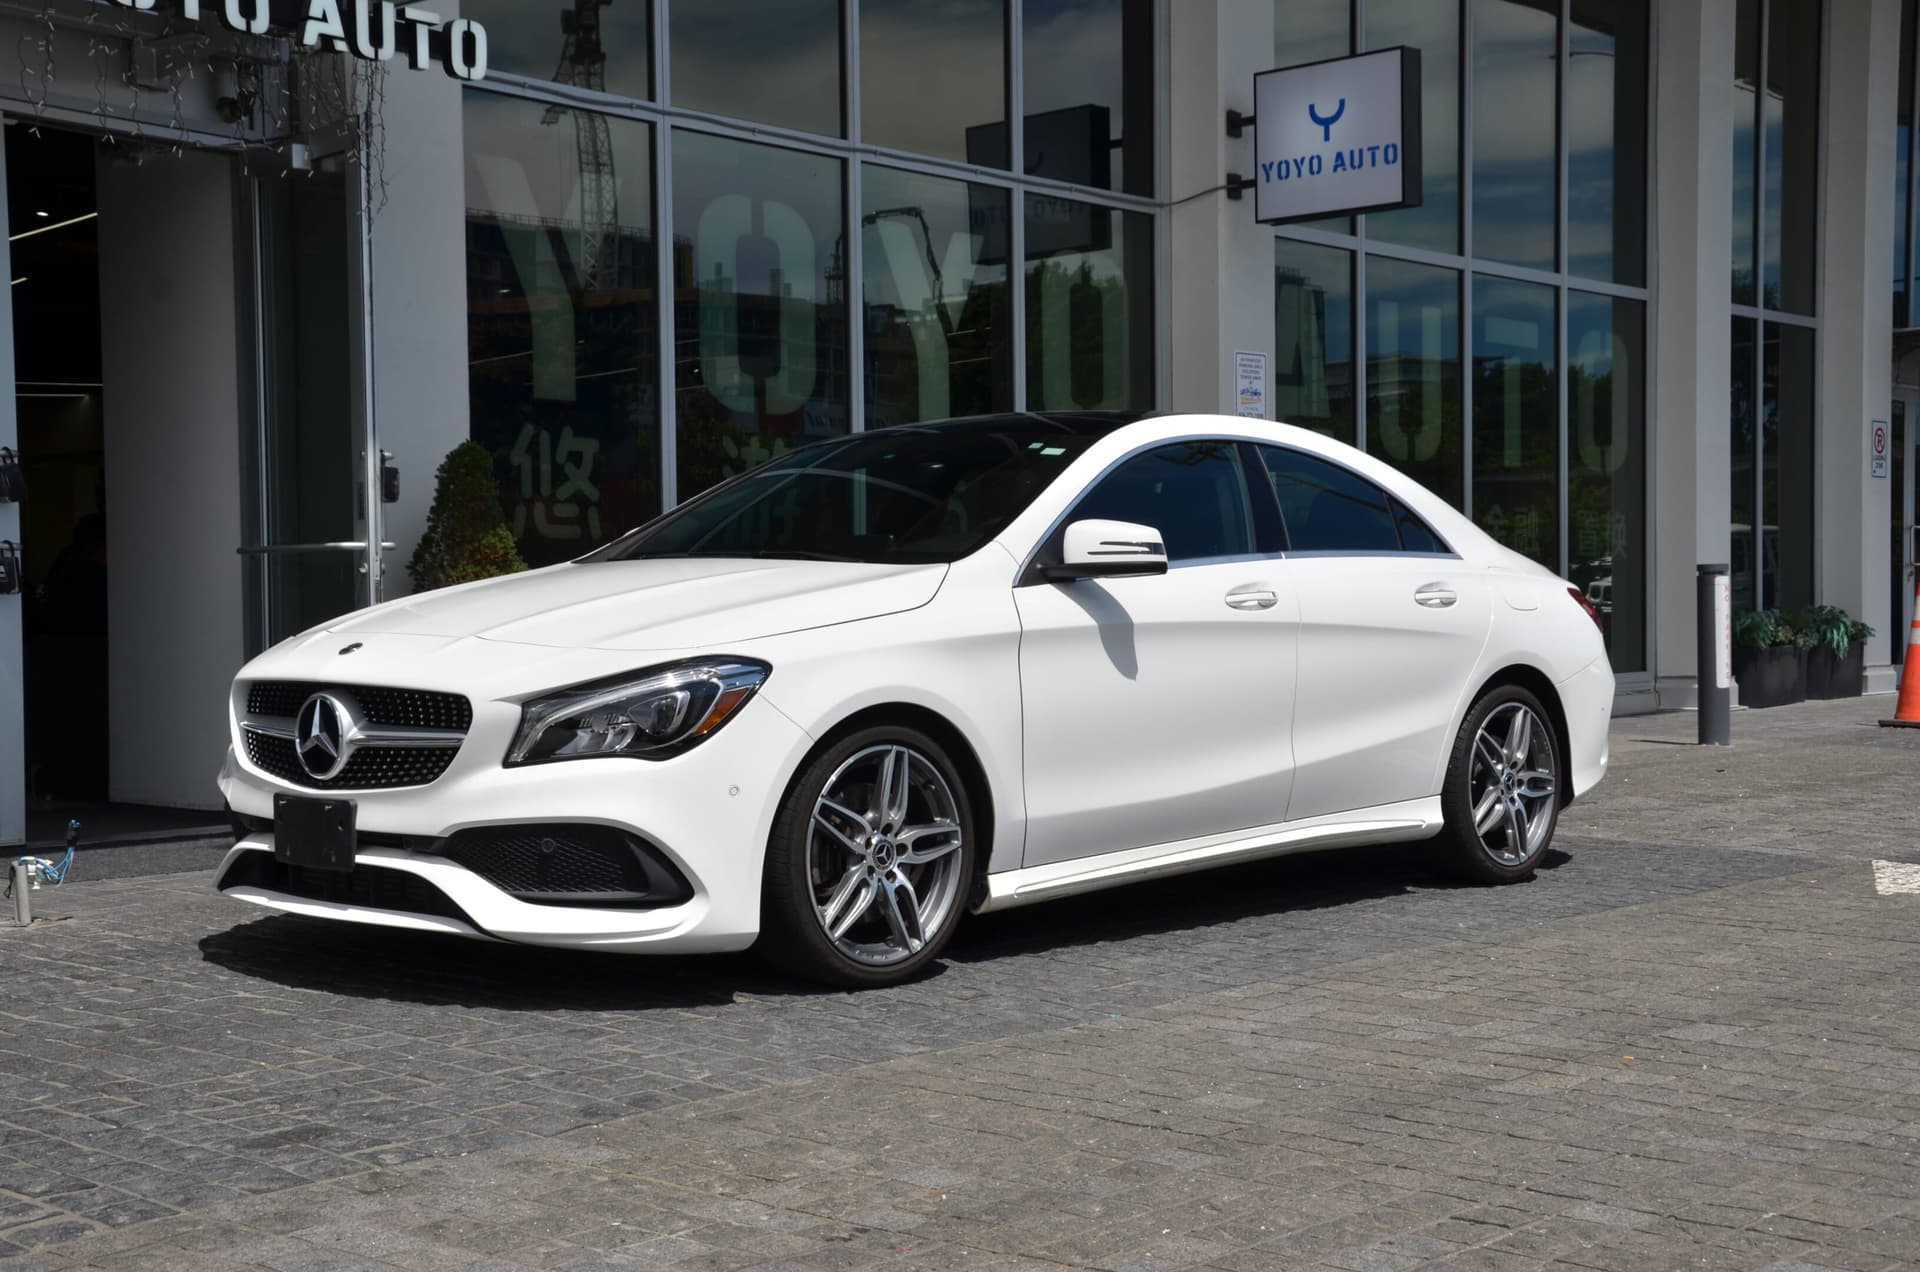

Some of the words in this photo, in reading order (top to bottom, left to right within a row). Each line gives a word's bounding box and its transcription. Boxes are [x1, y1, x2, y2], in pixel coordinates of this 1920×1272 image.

[302, 0, 488, 80] AUTO
[1261, 154, 1323, 184] YOYO
[1332, 143, 1399, 173] AUTO
